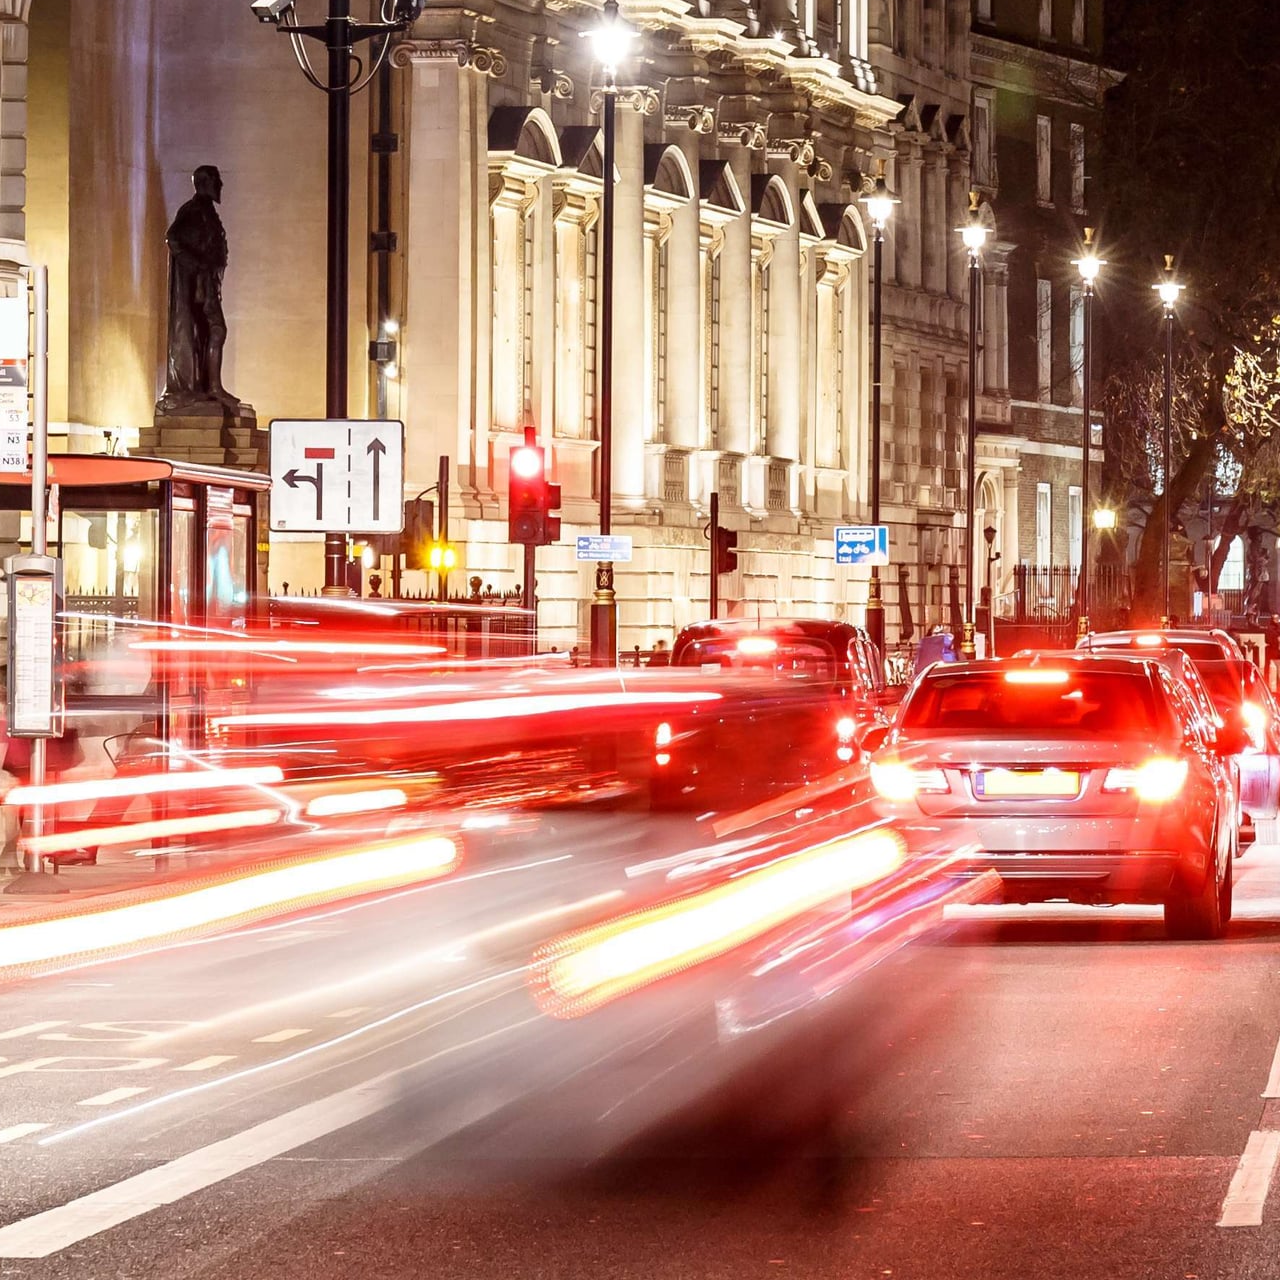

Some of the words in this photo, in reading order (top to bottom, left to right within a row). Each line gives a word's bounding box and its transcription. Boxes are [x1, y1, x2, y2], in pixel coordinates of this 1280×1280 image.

[9, 414, 20, 422] 53
[7, 436, 20, 444] N3
[2, 457, 25, 465] N381
